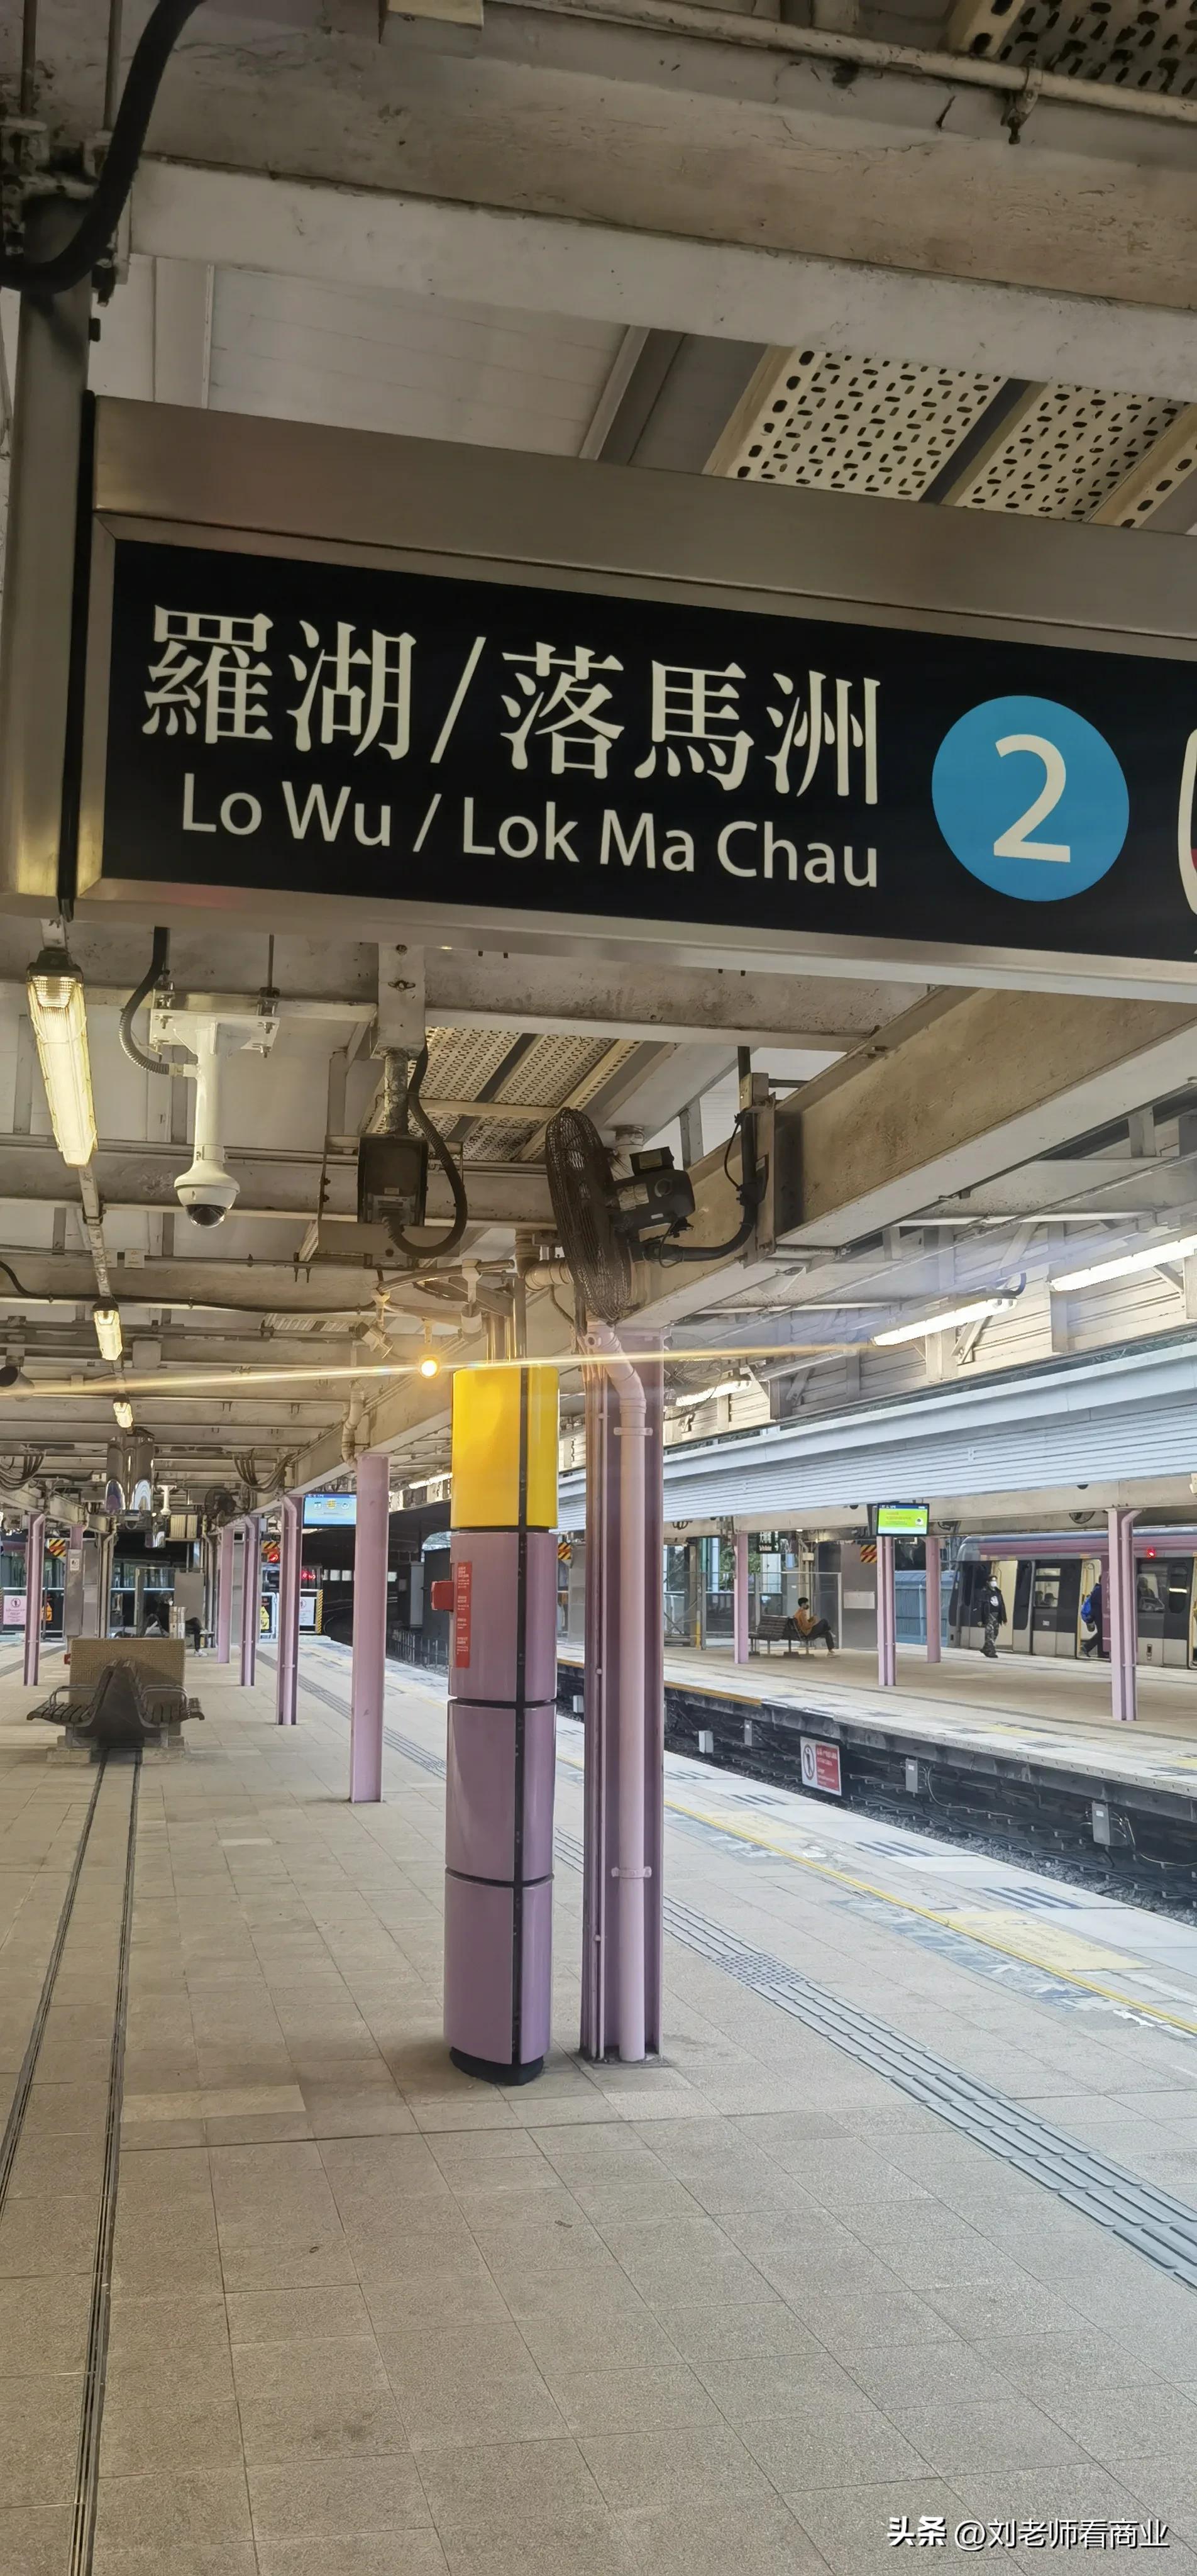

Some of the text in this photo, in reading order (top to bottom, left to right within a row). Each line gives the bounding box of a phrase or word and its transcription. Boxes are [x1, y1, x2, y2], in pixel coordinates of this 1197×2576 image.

[143, 605, 881, 805] 羅湖/落馬洲
[183, 773, 877, 887] Lo Wu / Lok Ma Chau
[993, 734, 1071, 863] 2
